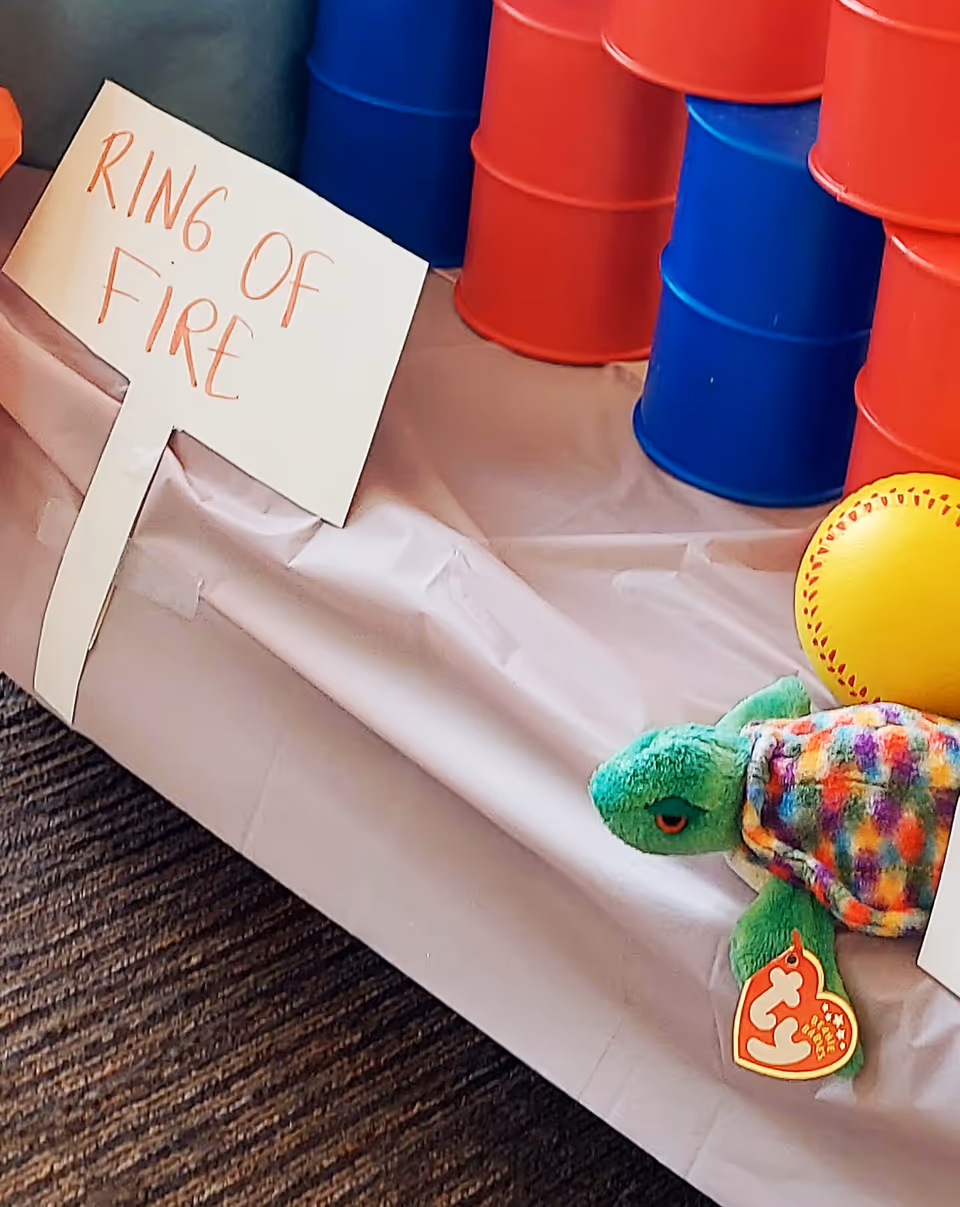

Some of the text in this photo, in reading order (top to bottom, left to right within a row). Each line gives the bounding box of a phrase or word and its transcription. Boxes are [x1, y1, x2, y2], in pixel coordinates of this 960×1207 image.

[87, 130, 335, 328] RING OF
[98, 246, 254, 400] FIRE
